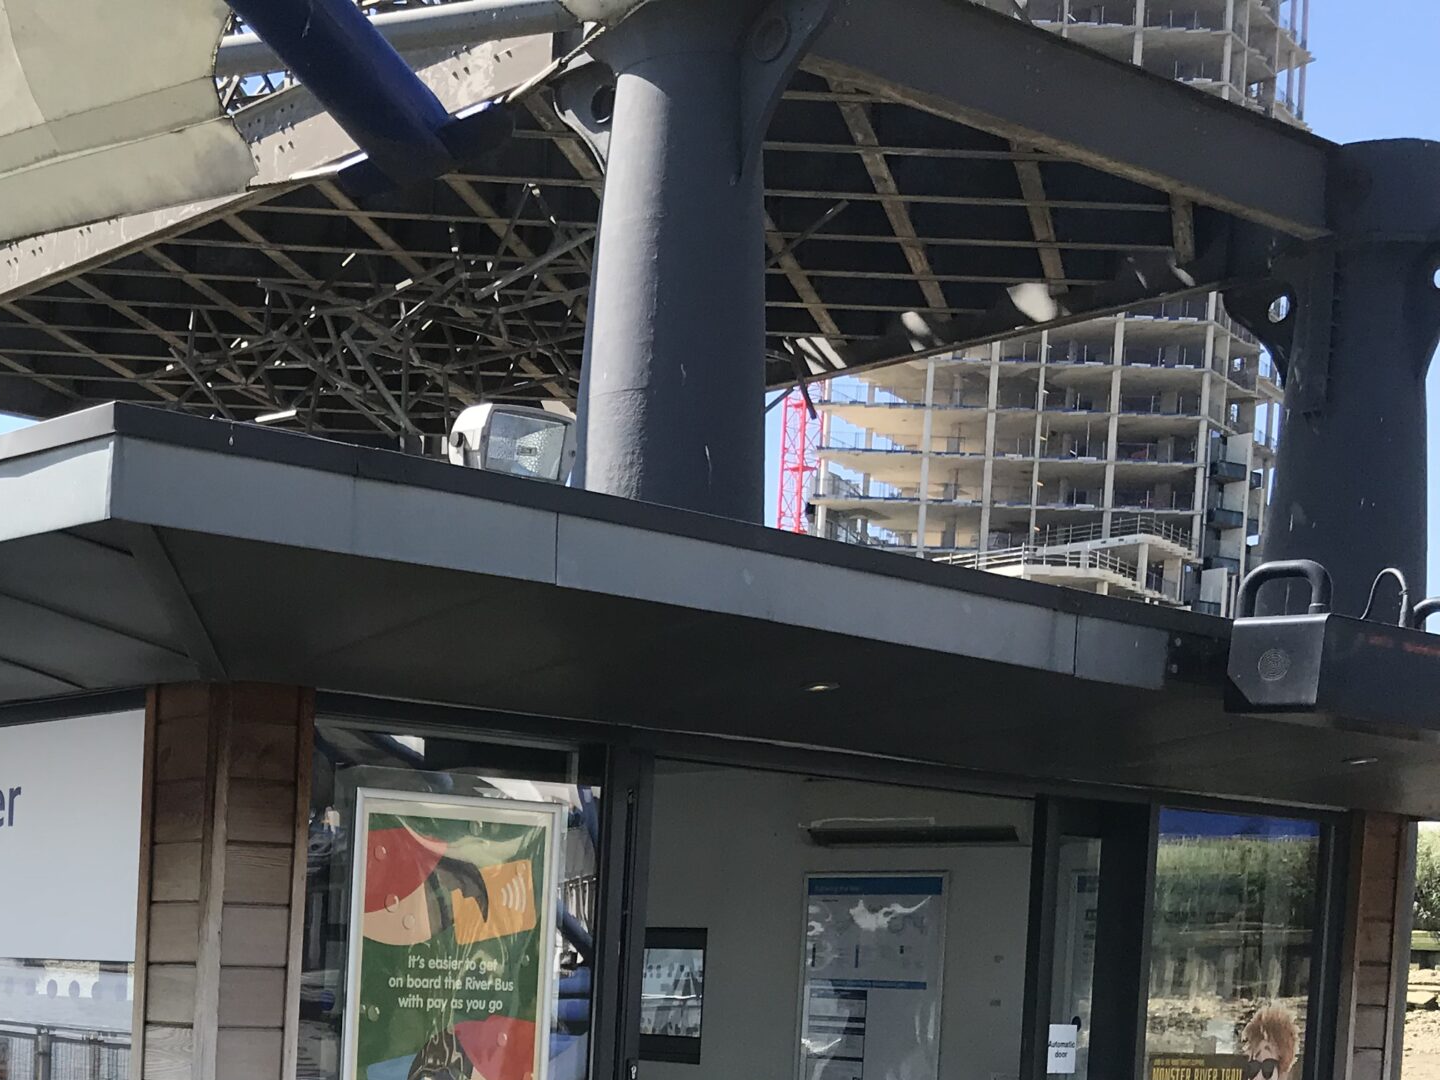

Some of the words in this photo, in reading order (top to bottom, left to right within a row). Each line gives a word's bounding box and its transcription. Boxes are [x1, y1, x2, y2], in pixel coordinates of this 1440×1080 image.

[428, 956, 463, 970] easier
[465, 958, 477, 970] to
[479, 959, 498, 974] get
[388, 976, 403, 988] on
[406, 974, 441, 988] board
[444, 975, 462, 989] the
[465, 977, 491, 990] River
[494, 978, 514, 991] Bus
[398, 994, 423, 1008] with
[426, 997, 448, 1012] pay
[450, 998, 463, 1009] as
[466, 999, 486, 1012] you
[488, 999, 503, 1013] go
[1048, 1040, 1075, 1049] Automatic
